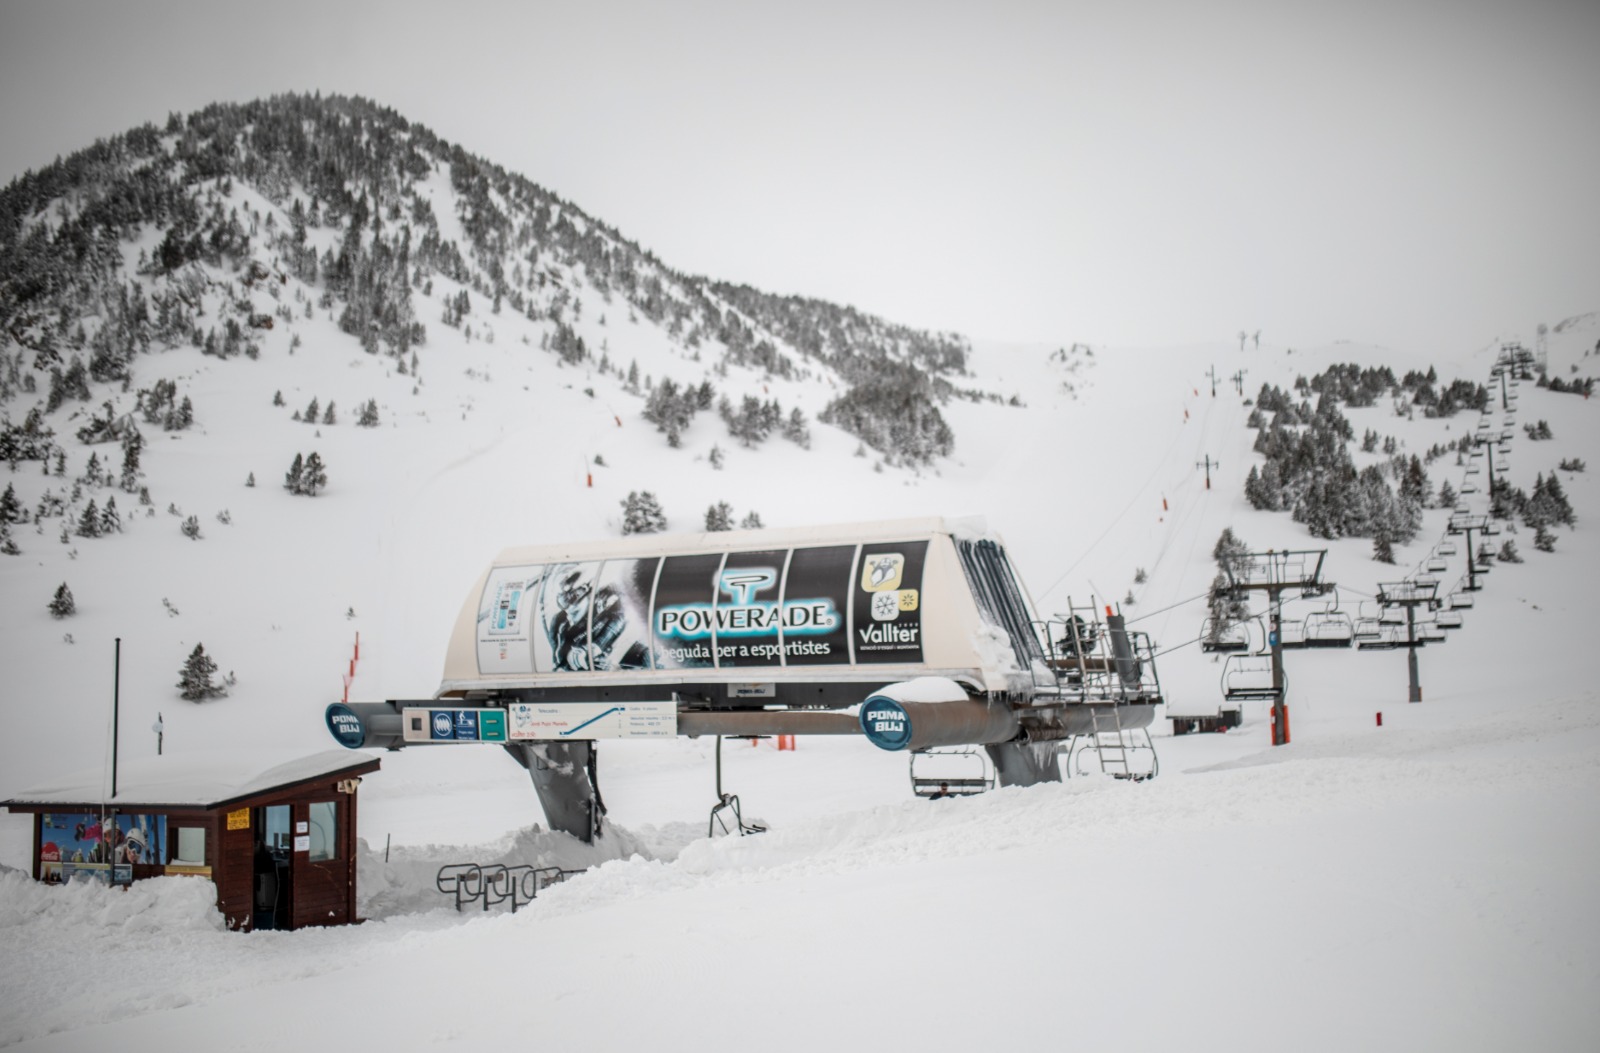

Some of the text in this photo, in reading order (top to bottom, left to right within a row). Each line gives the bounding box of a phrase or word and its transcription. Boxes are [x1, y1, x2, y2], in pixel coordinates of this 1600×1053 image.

[661, 605, 826, 632] POWERADE
[859, 623, 919, 644] Vallter
[739, 647, 750, 657] a
[751, 640, 831, 661] esportistes
[332, 715, 359, 725] POMA
[867, 711, 905, 721] POMA
[339, 724, 360, 733] BUJ
[875, 721, 904, 732] BUJ
